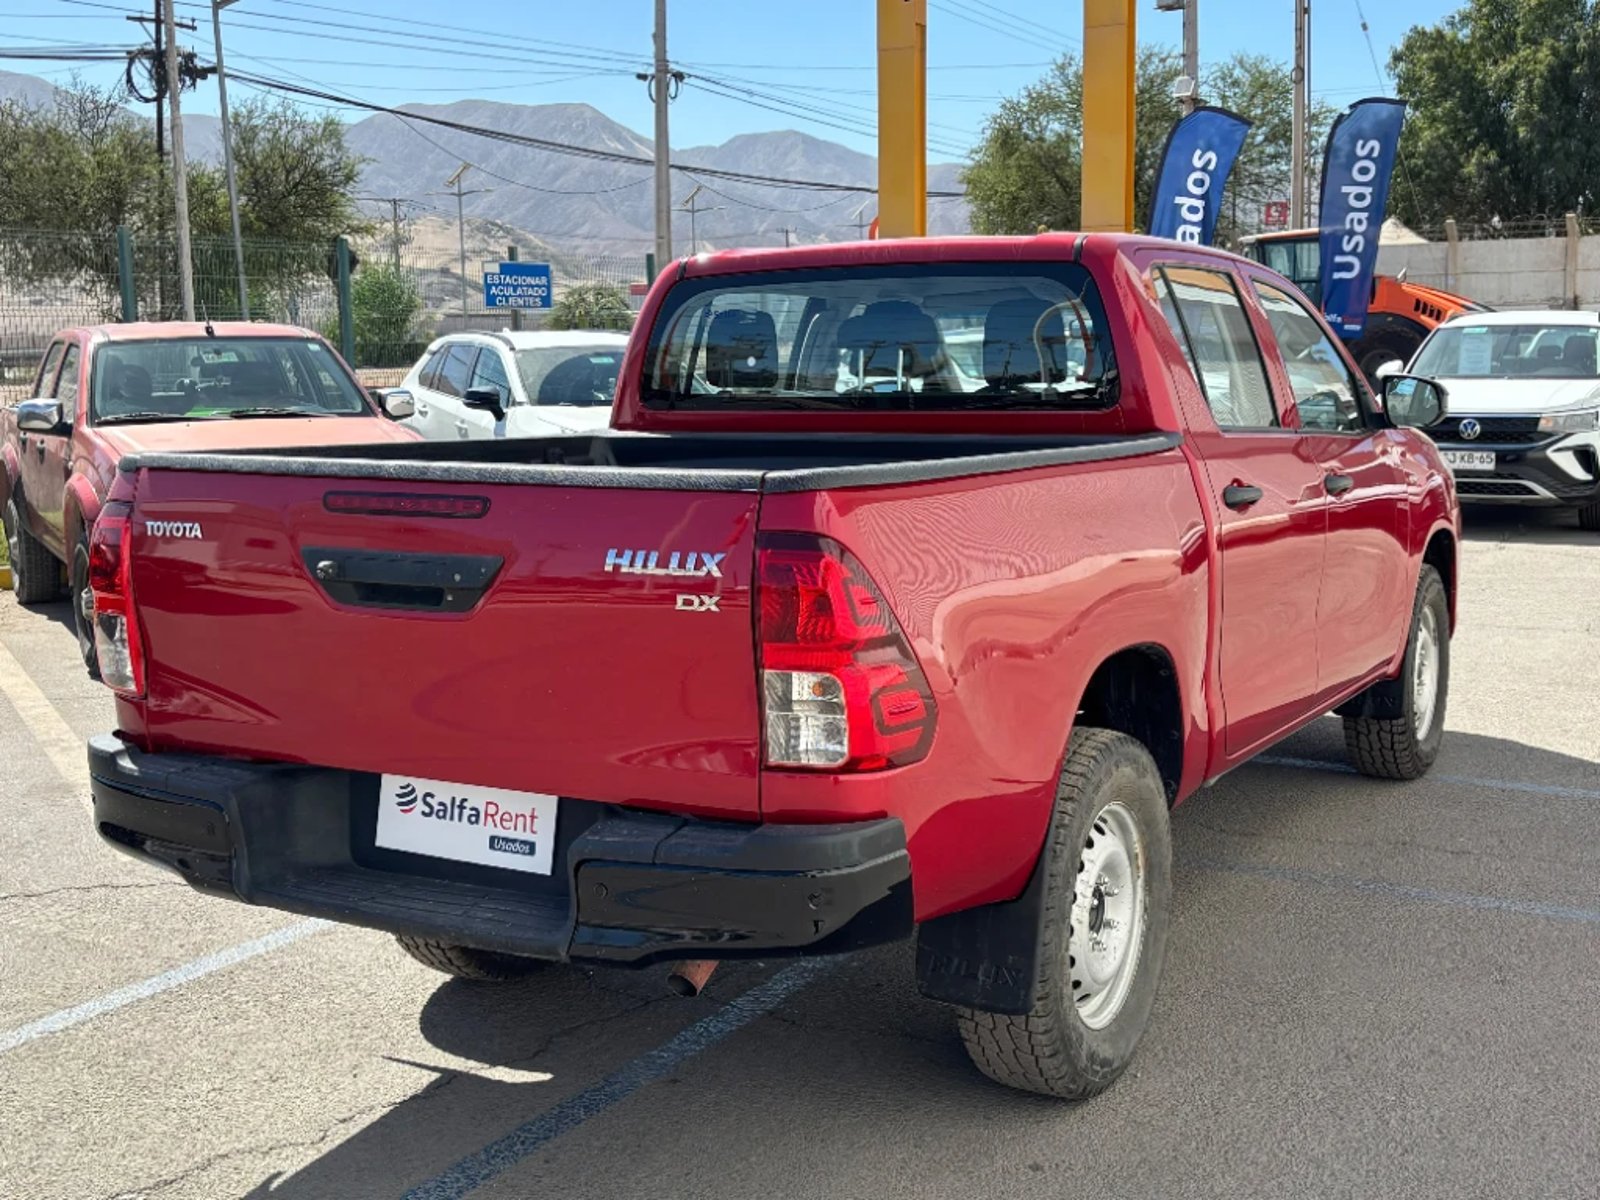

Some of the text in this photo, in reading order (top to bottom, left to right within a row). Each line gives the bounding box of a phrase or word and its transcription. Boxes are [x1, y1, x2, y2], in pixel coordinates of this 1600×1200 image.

[1332, 139, 1381, 280] Usados
[487, 275, 548, 285] ESTACIONAR
[490, 286, 548, 296] ACULATADO
[496, 297, 543, 307] CLIENTES
[145, 521, 203, 539] TOYOTA
[604, 548, 726, 577] HILUX
[675, 593, 720, 612] DX
[421, 791, 539, 834] SalfaRent
[494, 838, 531, 854] Usados
